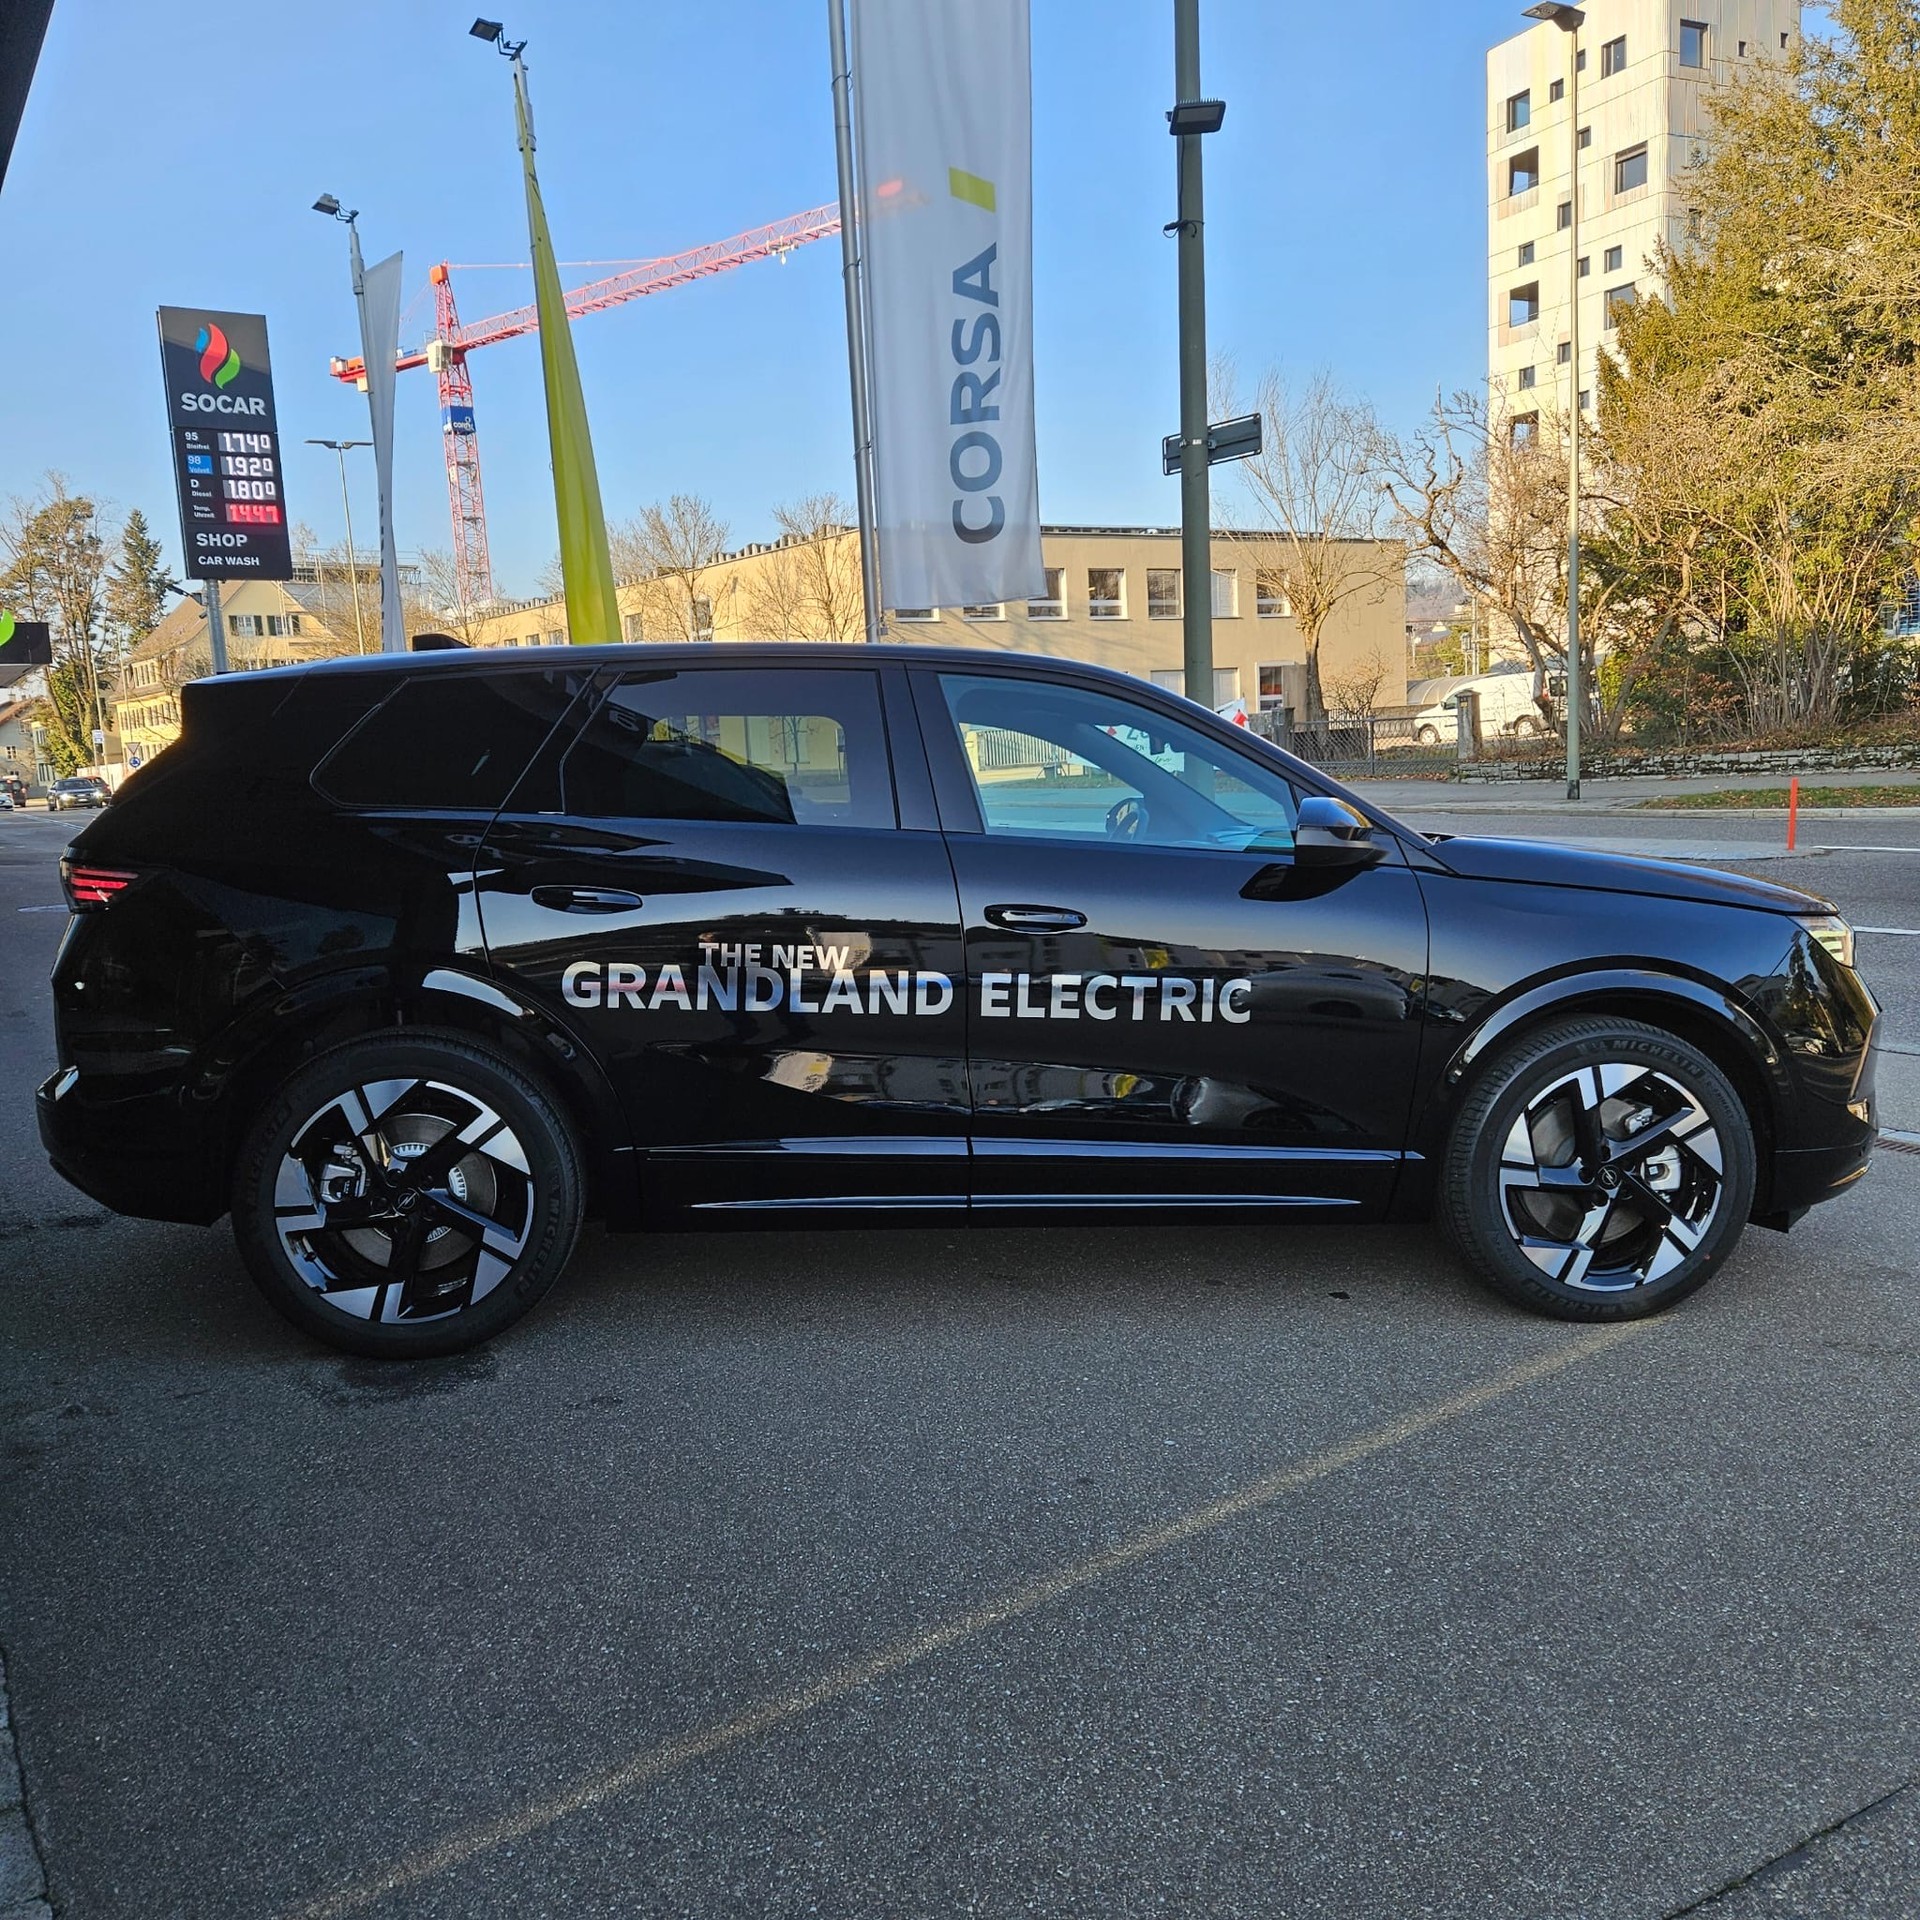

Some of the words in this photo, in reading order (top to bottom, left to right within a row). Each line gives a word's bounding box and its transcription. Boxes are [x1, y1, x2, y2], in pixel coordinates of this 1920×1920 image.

[181, 392, 267, 416] SOCAR
[950, 241, 1005, 544] CORSA
[185, 432, 198, 441] 95
[188, 455, 201, 465] 98
[191, 479, 199, 488] D
[196, 533, 248, 547] SHOP
[198, 556, 223, 565] CAR
[225, 556, 260, 566] WASH
[698, 942, 762, 967] THE
[772, 944, 850, 970] NEW
[562, 961, 954, 1016] GRANDLAND
[980, 973, 1251, 1023] ELECTRIC
[1612, 1039, 1702, 1078] MICHELIN
[518, 1198, 561, 1294] MICHELIN
